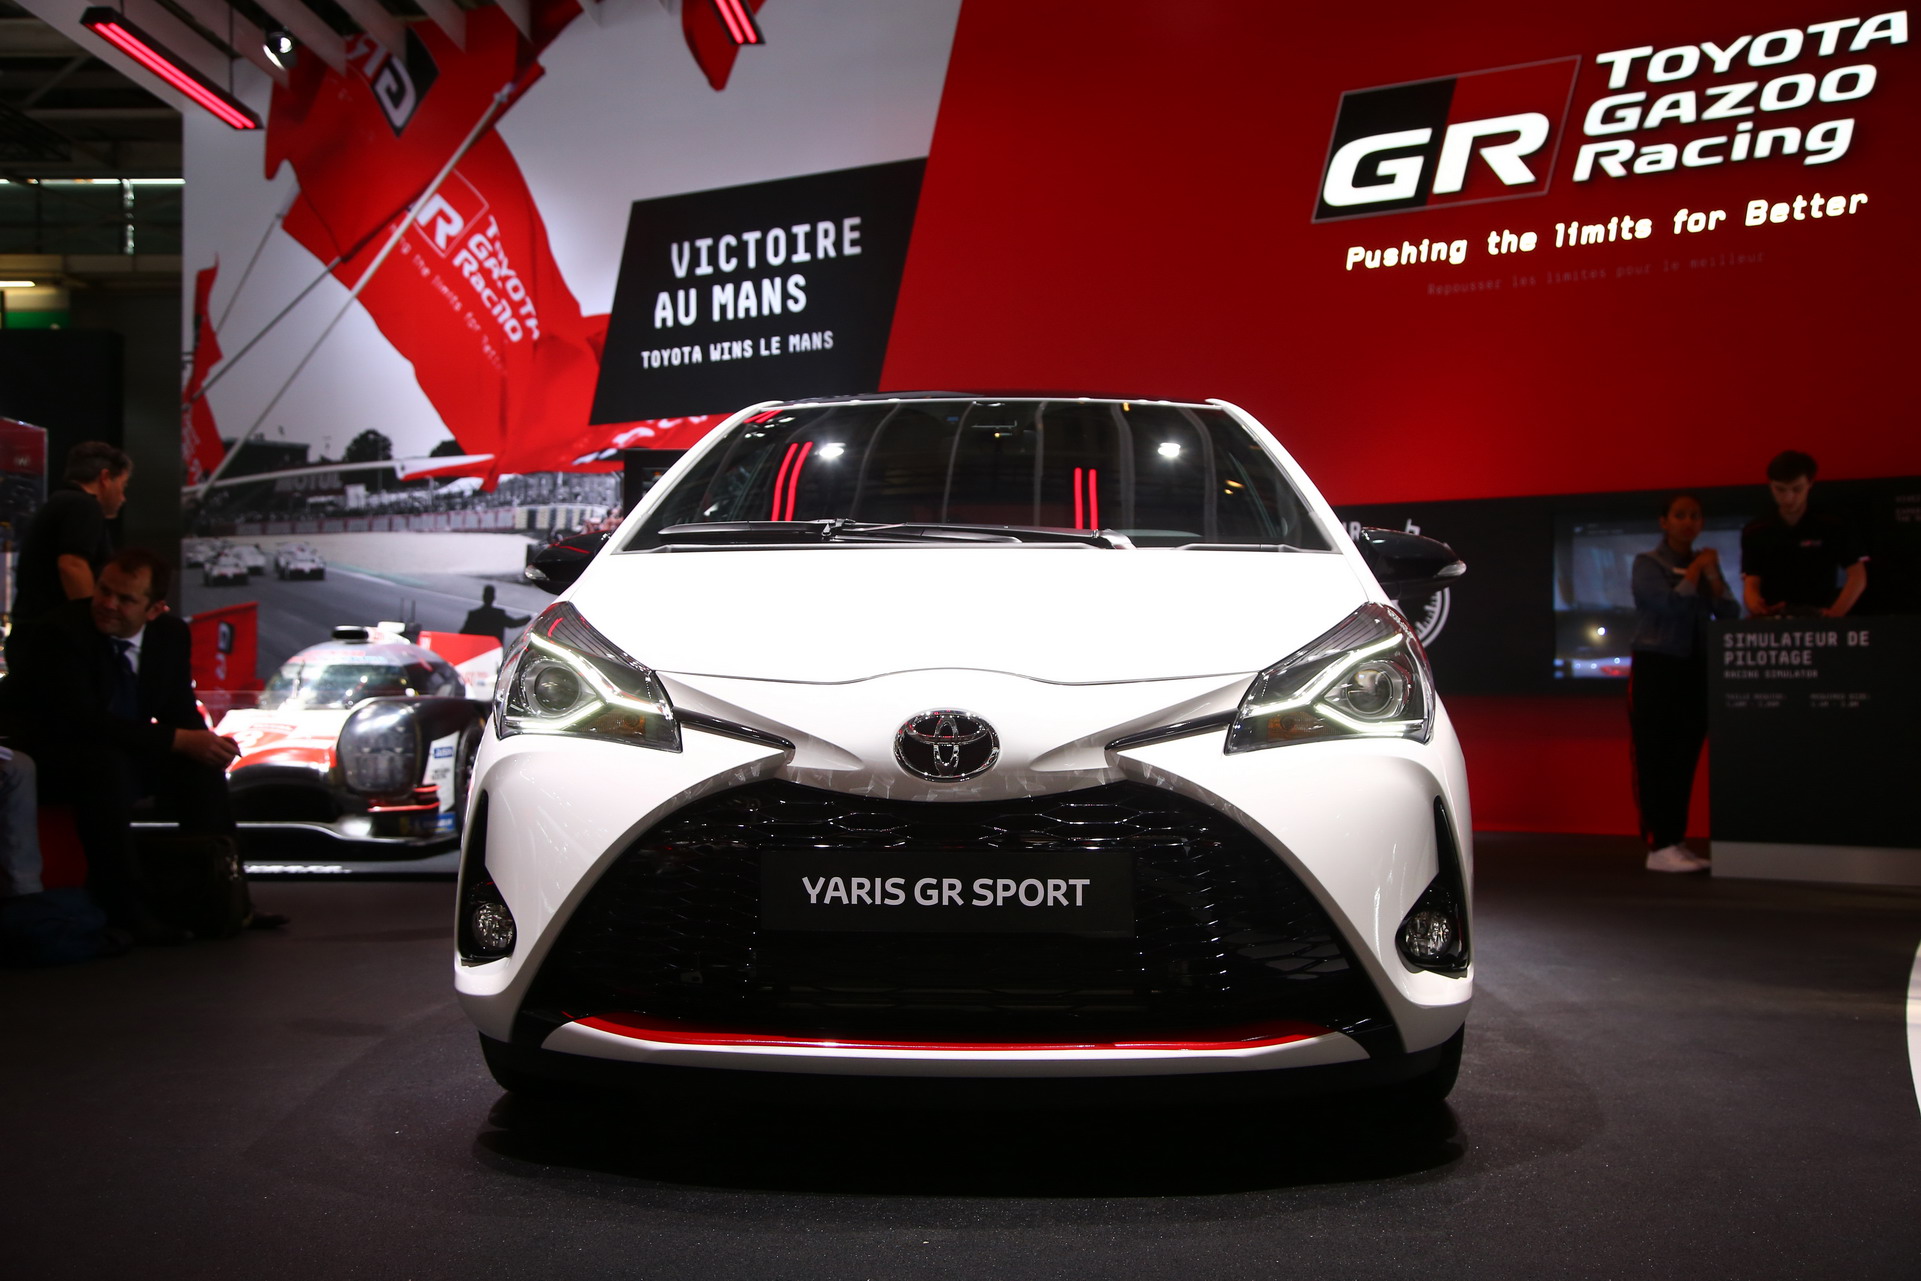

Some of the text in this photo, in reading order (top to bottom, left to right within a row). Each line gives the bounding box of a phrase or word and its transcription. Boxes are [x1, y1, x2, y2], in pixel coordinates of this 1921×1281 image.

[1595, 10, 1908, 90] TOYOTA
[1583, 63, 1878, 137] GAZOO
[1322, 112, 1550, 207] GR
[1572, 118, 1855, 182] Racing
[670, 216, 863, 280] VICTOIRE
[1345, 192, 1869, 271] Pushing the limits for Better
[653, 273, 808, 330] AU MANS
[640, 330, 834, 369] TOYOTA WINS LE MANS
[1723, 631, 1870, 648] SIMULATEUR DE
[1723, 650, 1813, 666] PILOTAGE
[801, 876, 1091, 907] YARIS GR SPORT
